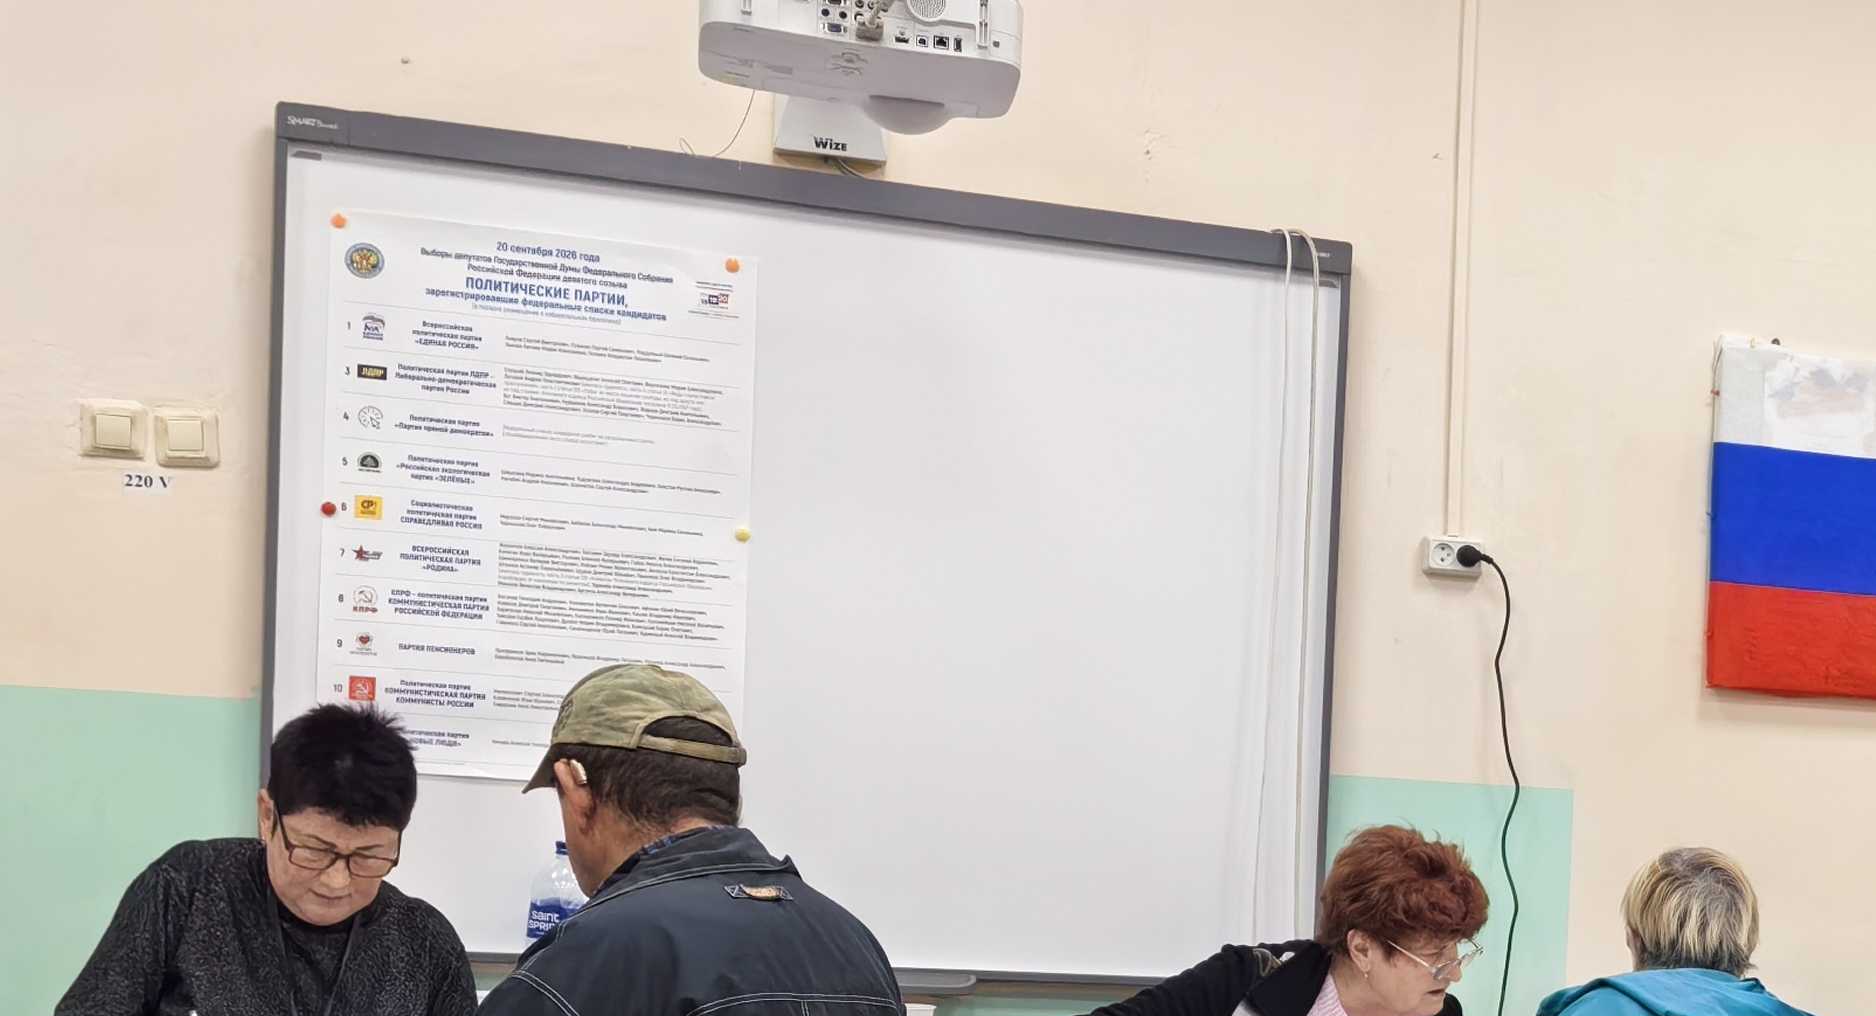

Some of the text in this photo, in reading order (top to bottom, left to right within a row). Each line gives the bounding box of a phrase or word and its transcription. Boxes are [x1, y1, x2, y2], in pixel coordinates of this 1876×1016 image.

[497, 242, 507, 252] 20
[510, 245, 553, 258] сентября
[580, 252, 600, 263] года
[421, 247, 673, 283] Выборы депутатов Государственной Думы Федерального Собрания
[467, 263, 627, 289] Российской Федерации девятого созыва
[466, 276, 628, 307] ПОЛИТИЧЕСКИЕ ПАРТИИ,
[425, 287, 519, 305] зарегистрировавшие
[521, 296, 581, 311] федеральные
[584, 304, 614, 316] списки
[617, 307, 666, 321] кандидатов
[343, 412, 349, 420] 4
[342, 457, 347, 465] 5
[125, 474, 173, 488] 220 V
[342, 502, 347, 510] 6
[337, 639, 342, 647] 9
[333, 684, 342, 692] 10
